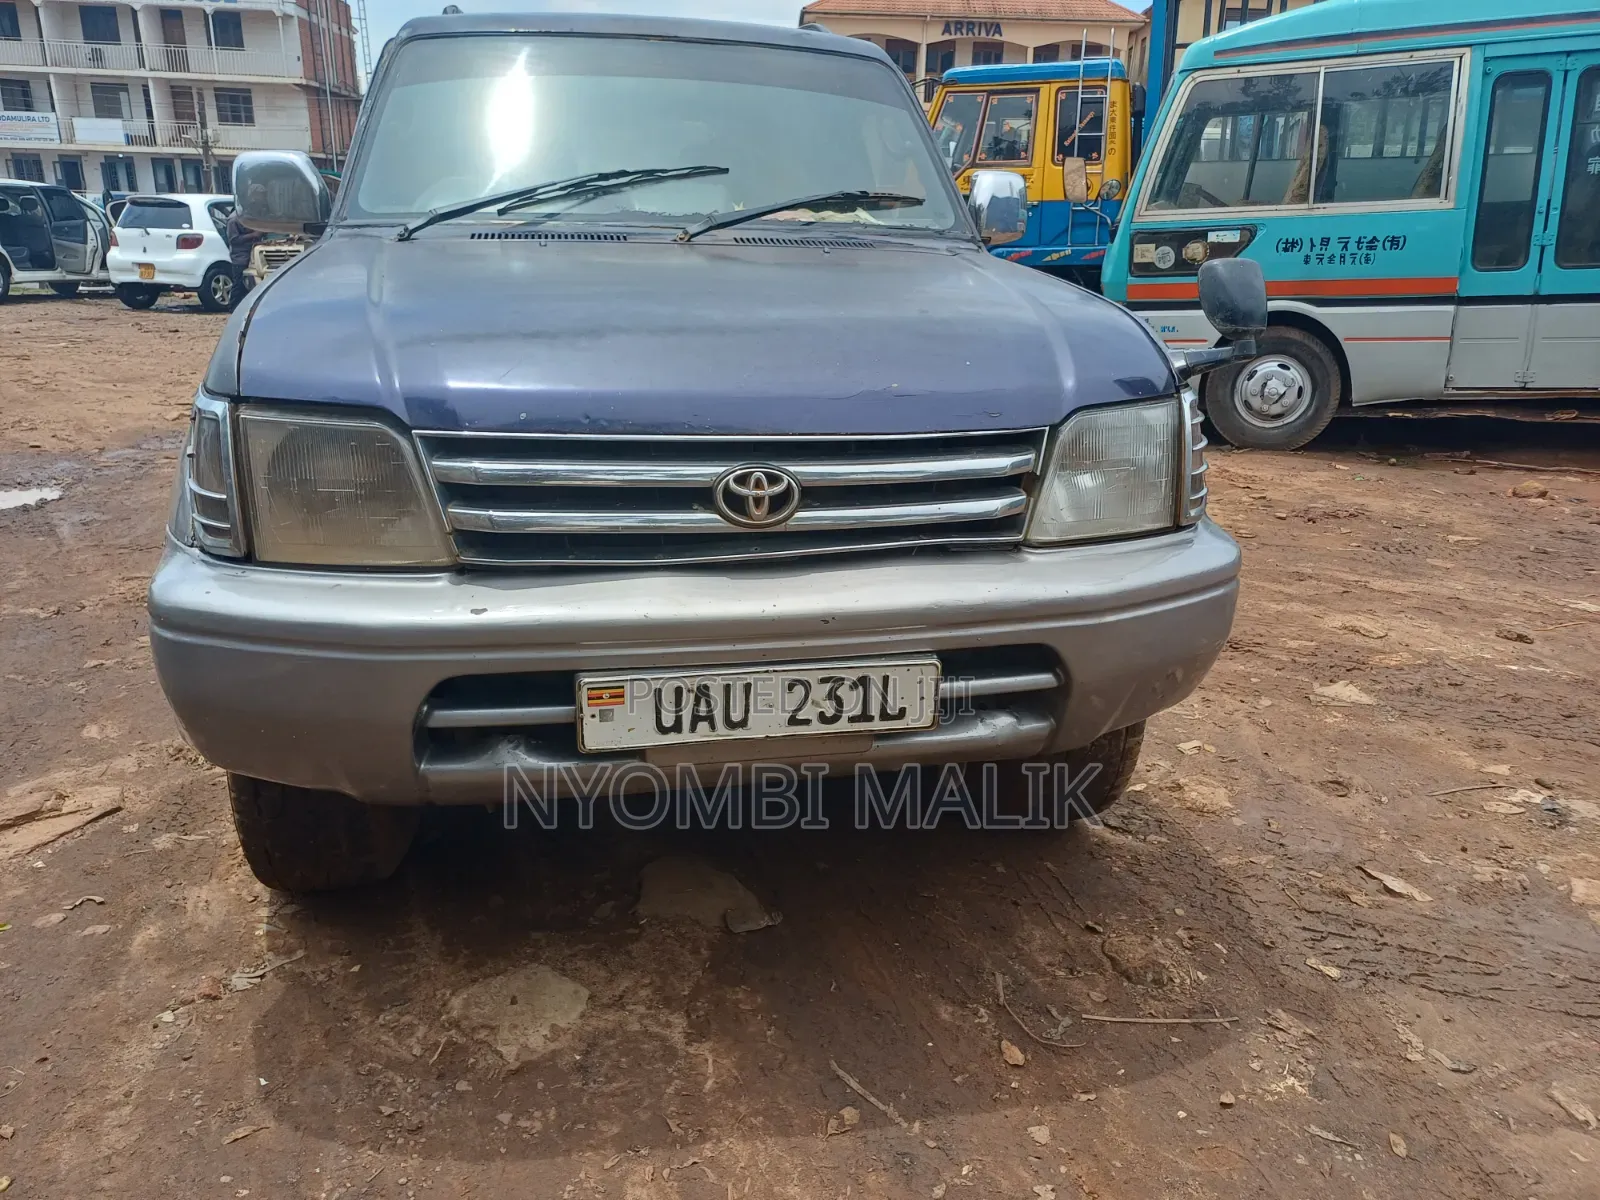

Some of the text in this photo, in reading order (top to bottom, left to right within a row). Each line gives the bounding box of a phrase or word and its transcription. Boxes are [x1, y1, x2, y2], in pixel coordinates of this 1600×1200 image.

[941, 21, 1003, 37] ARRIVA
[0, 114, 37, 122] DAMULIRA
[654, 674, 907, 736] UAU 231L
